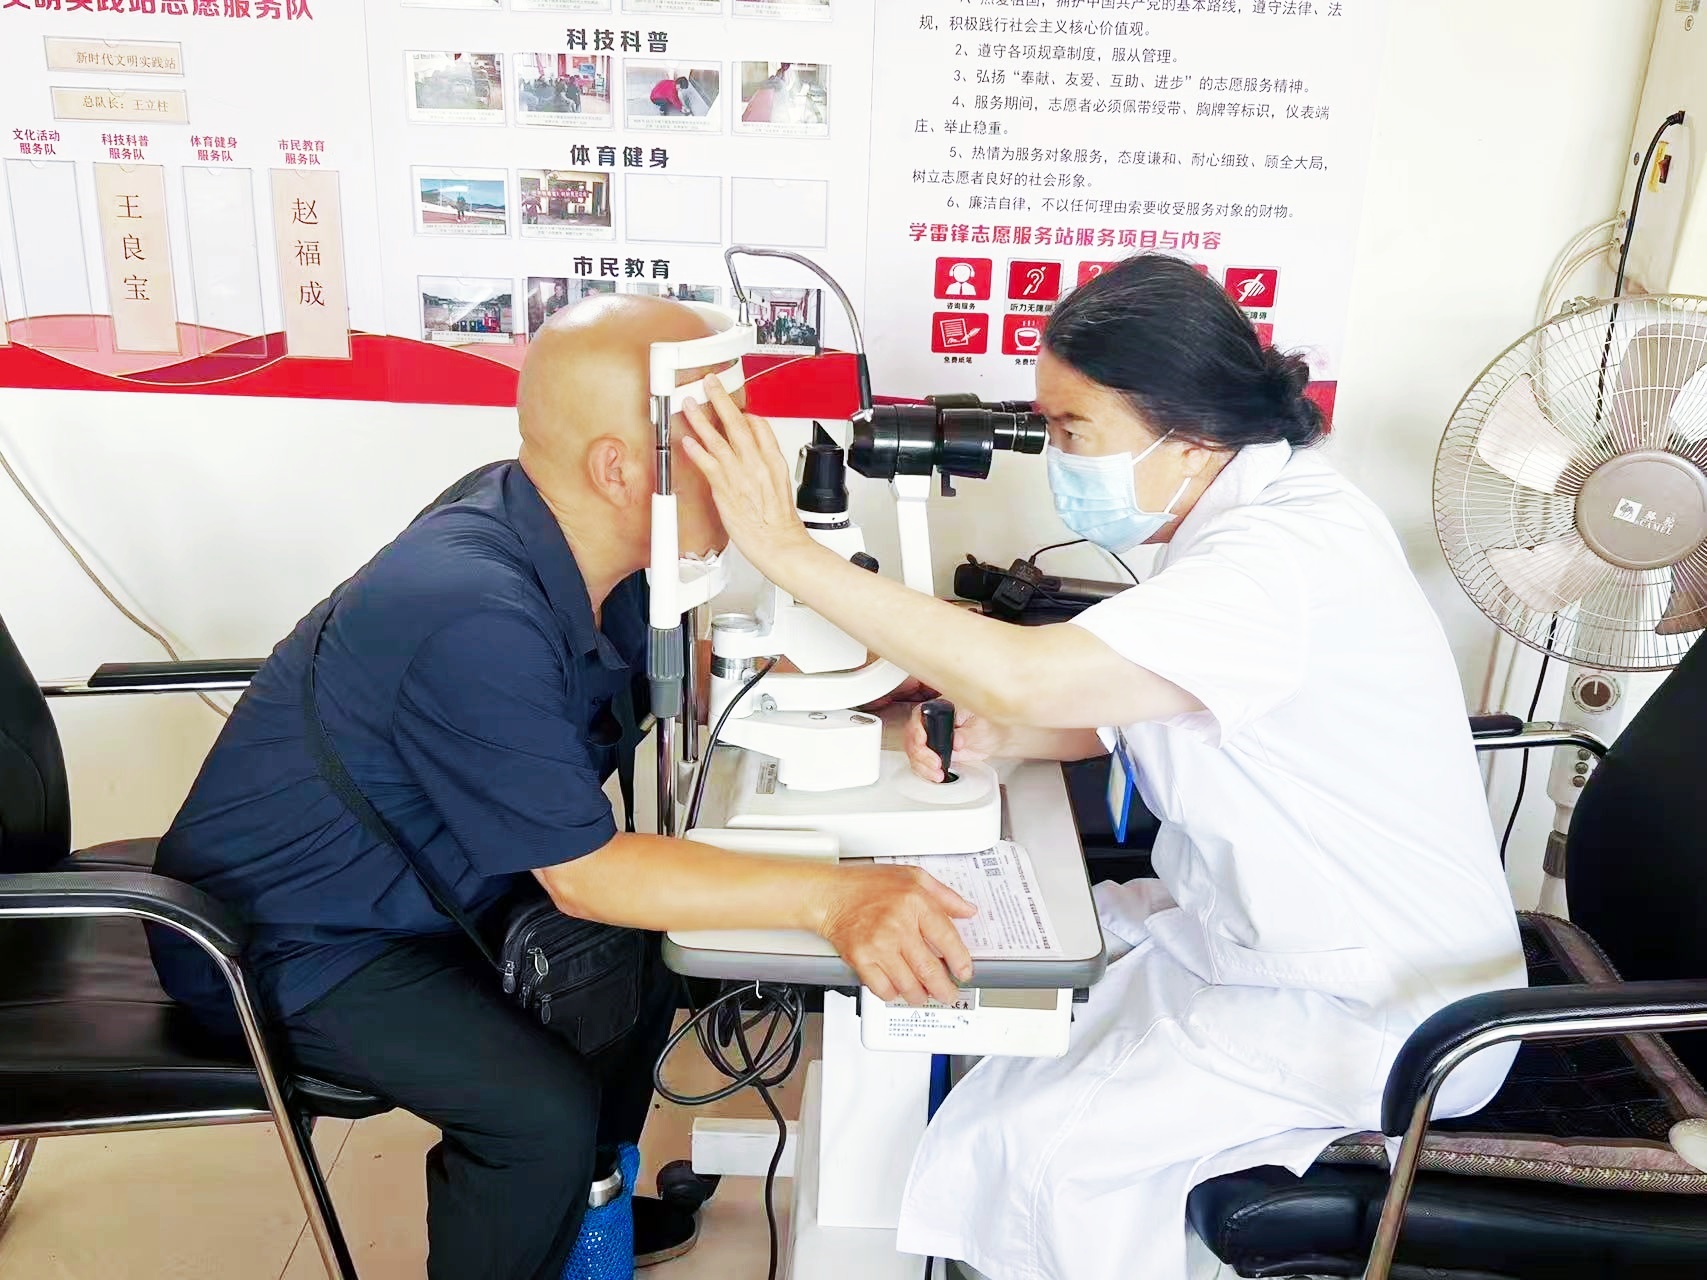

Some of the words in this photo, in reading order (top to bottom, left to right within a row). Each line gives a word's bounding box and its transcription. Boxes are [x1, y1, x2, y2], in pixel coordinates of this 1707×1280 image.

[959, 0, 1343, 17] 、国，拥护中国共产党的基本路线，遵守法律、法
[919, 14, 1151, 37] 规，积极践行社会主义核心价值观。
[566, 28, 669, 53] 科技科普
[76, 52, 176, 69] 新时代文明实践站
[955, 43, 1178, 63] 2、遵守各项规章制度，服从管理。
[953, 69, 1309, 94] 3、弘扬“奉献、友爱、互助、进步”的志愿服务精神。
[12, 128, 61, 142] 文化活动
[914, 118, 1010, 136] 庄、举止稳重。
[19, 142, 57, 155] 服务队
[101, 133, 149, 147] 科技科普
[190, 135, 238, 149] 体育健身
[278, 139, 325, 152] 市民教育
[109, 147, 145, 160] 服务队
[197, 149, 233, 162] 服务队
[285, 152, 321, 165] 服务队
[570, 144, 670, 169] 体育健身
[949, 146, 1329, 171] 5、热情为服务对象服务，态度谦和、耐心细致、顾全大局，
[912, 168, 1093, 188] 树立志愿者良好的社会形象。
[946, 195, 1294, 218] 6、廉洁自律，不以任何理由索要收受服务对象的财物。
[909, 222, 1222, 250] 学雷锋志愿服务站服务项目与内容
[115, 194, 150, 301] 王良宝
[291, 197, 326, 307] 赵福成
[573, 255, 670, 280] 市民教育
[946, 302, 976, 310] 咨询服务
[943, 356, 972, 364] 免费纸笔
[1015, 358, 1037, 366] 免费饮
[1640, 519, 1673, 537] CAMEL
